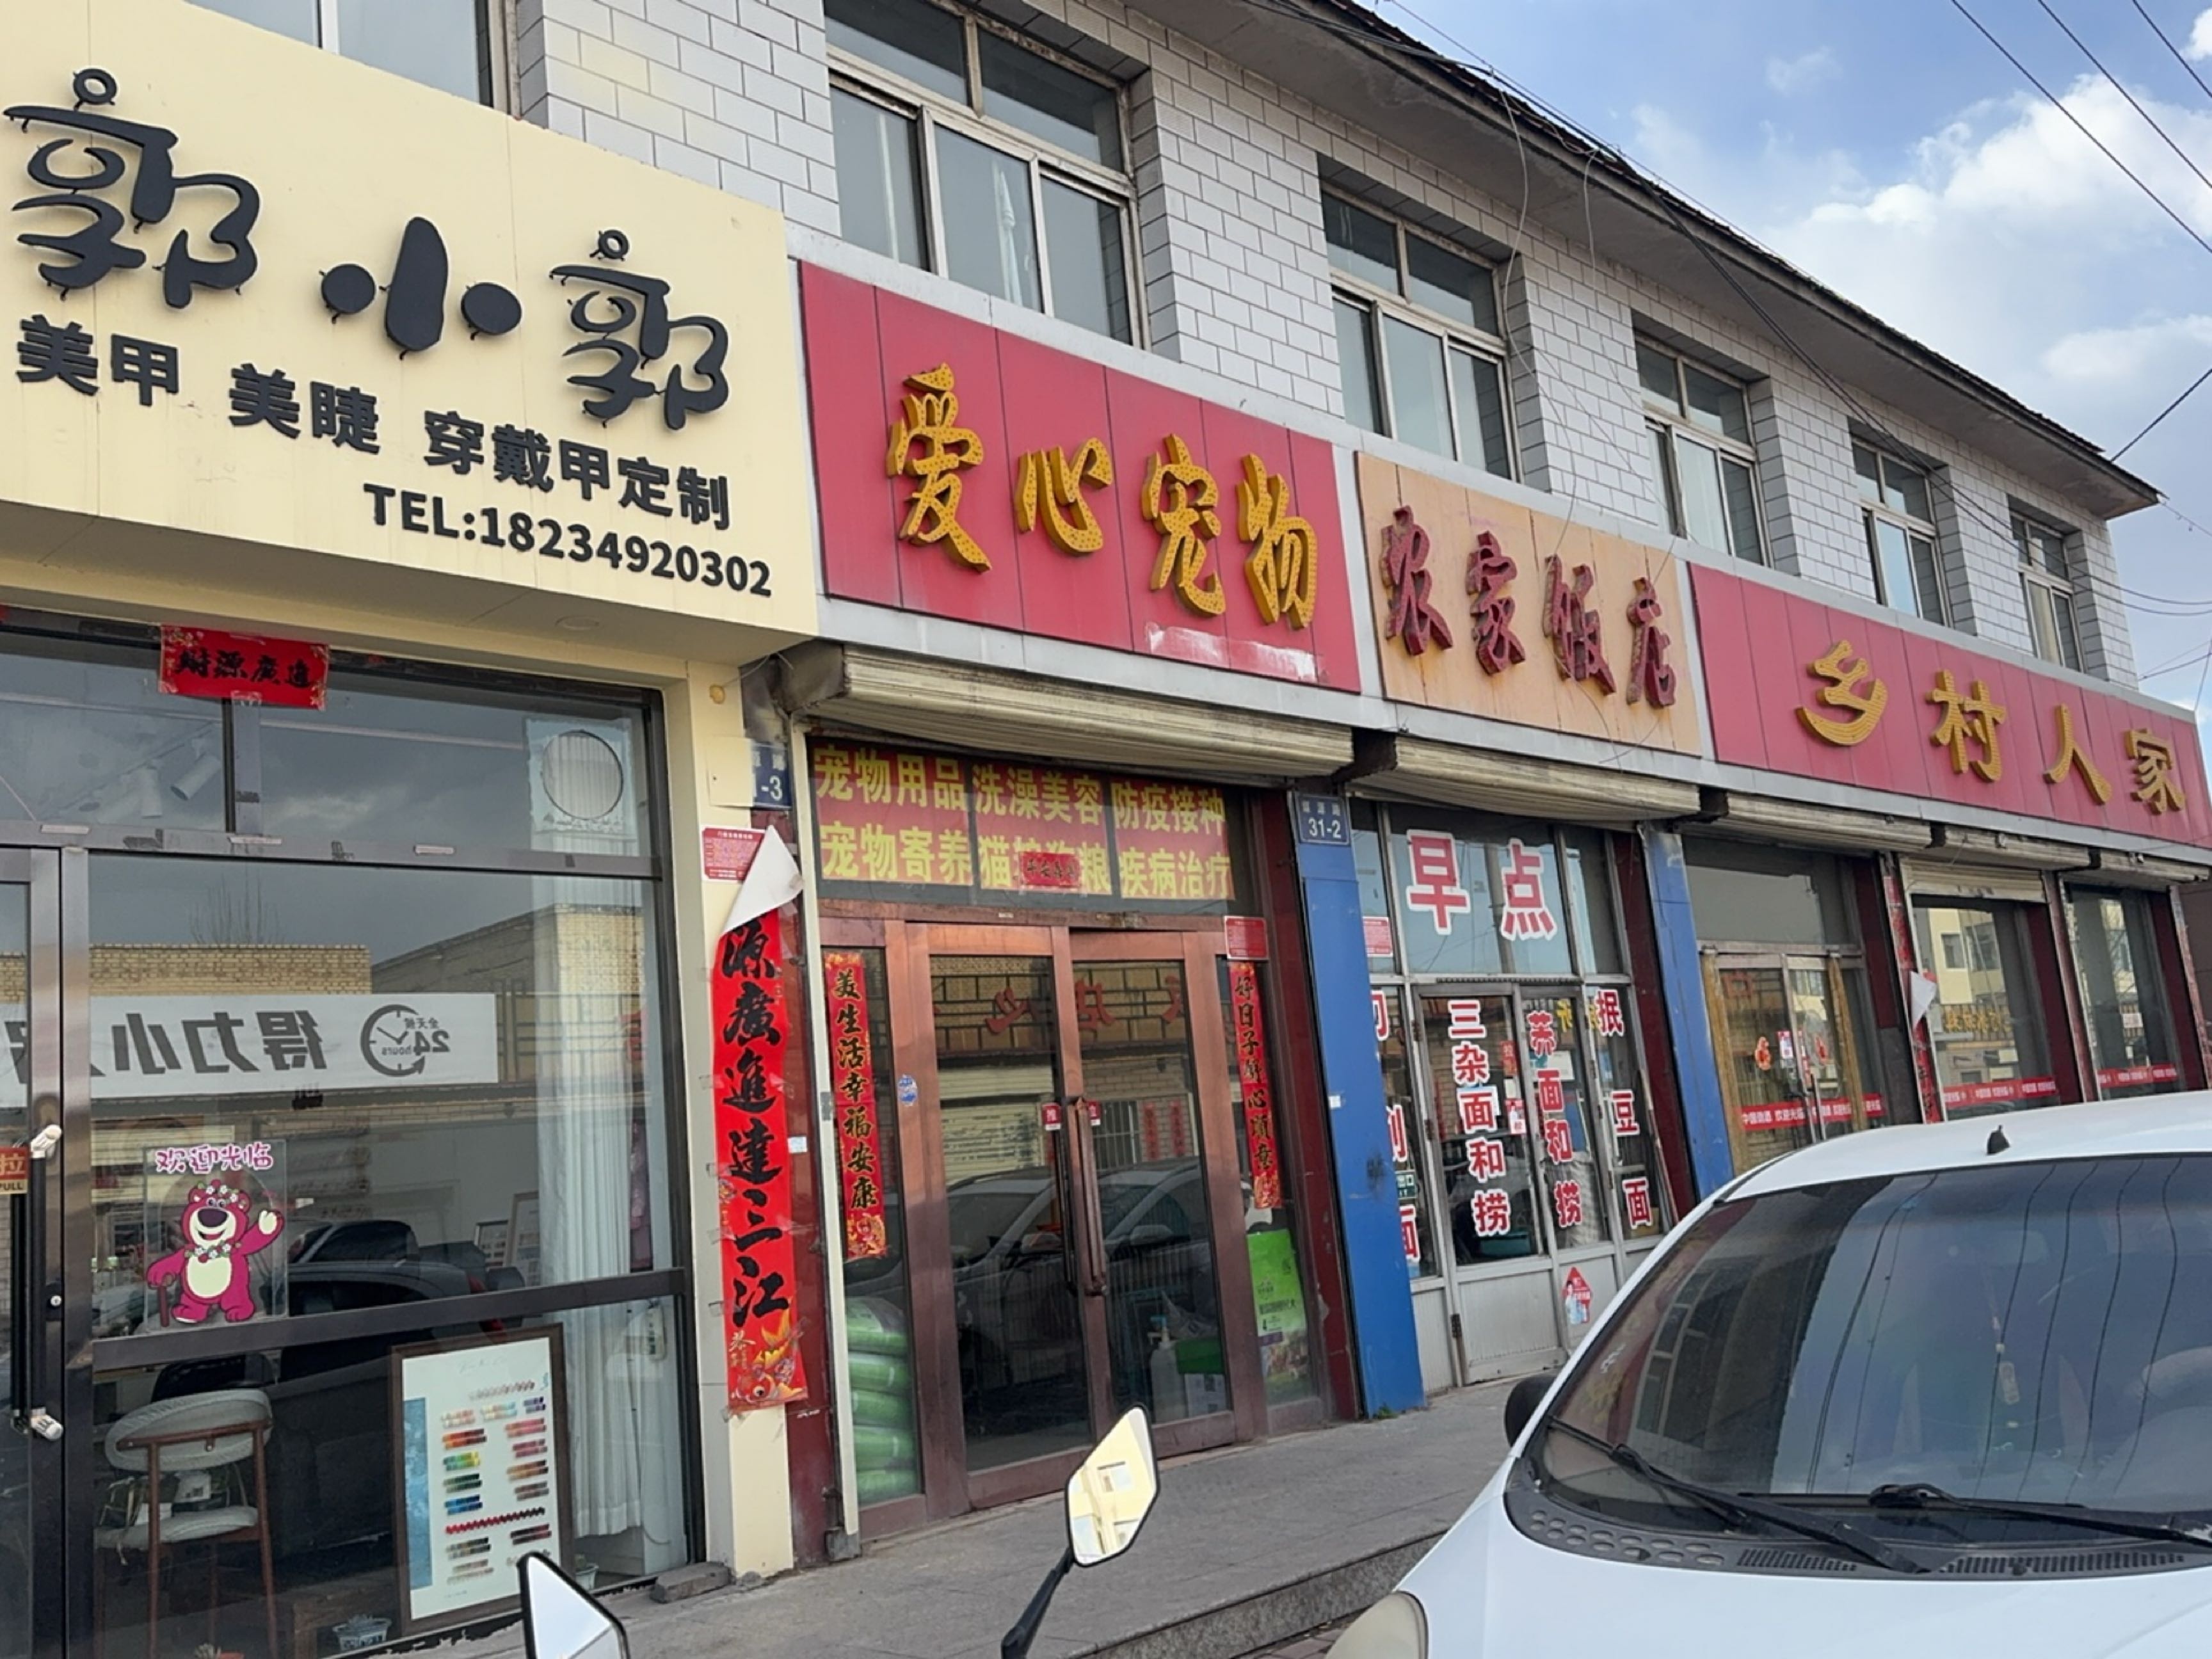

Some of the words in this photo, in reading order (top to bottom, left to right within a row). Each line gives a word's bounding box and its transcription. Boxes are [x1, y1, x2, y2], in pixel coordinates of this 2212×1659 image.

[16, 314, 180, 408] 美甲
[228, 362, 381, 455] 美睫
[424, 410, 732, 531] 穿戴甲定制
[886, 361, 1318, 630] 爱心宠物
[362, 482, 773, 598] TEL:18234920302
[1381, 504, 1677, 710] 农家饭店
[1796, 640, 2186, 817] 乡村人家
[814, 745, 965, 812] 宠物用品
[972, 764, 1103, 826] 洗澡美容
[1111, 781, 1225, 836] 防疫接种
[821, 821, 972, 885] 宠物寄养
[1308, 817, 1342, 839] 31-2
[1118, 851, 1232, 899] 疾病治疗
[1408, 831, 1556, 940] 早点
[155, 1142, 274, 1174] 欢迎光临
[1448, 1000, 1510, 1236] 三杂面和捞
